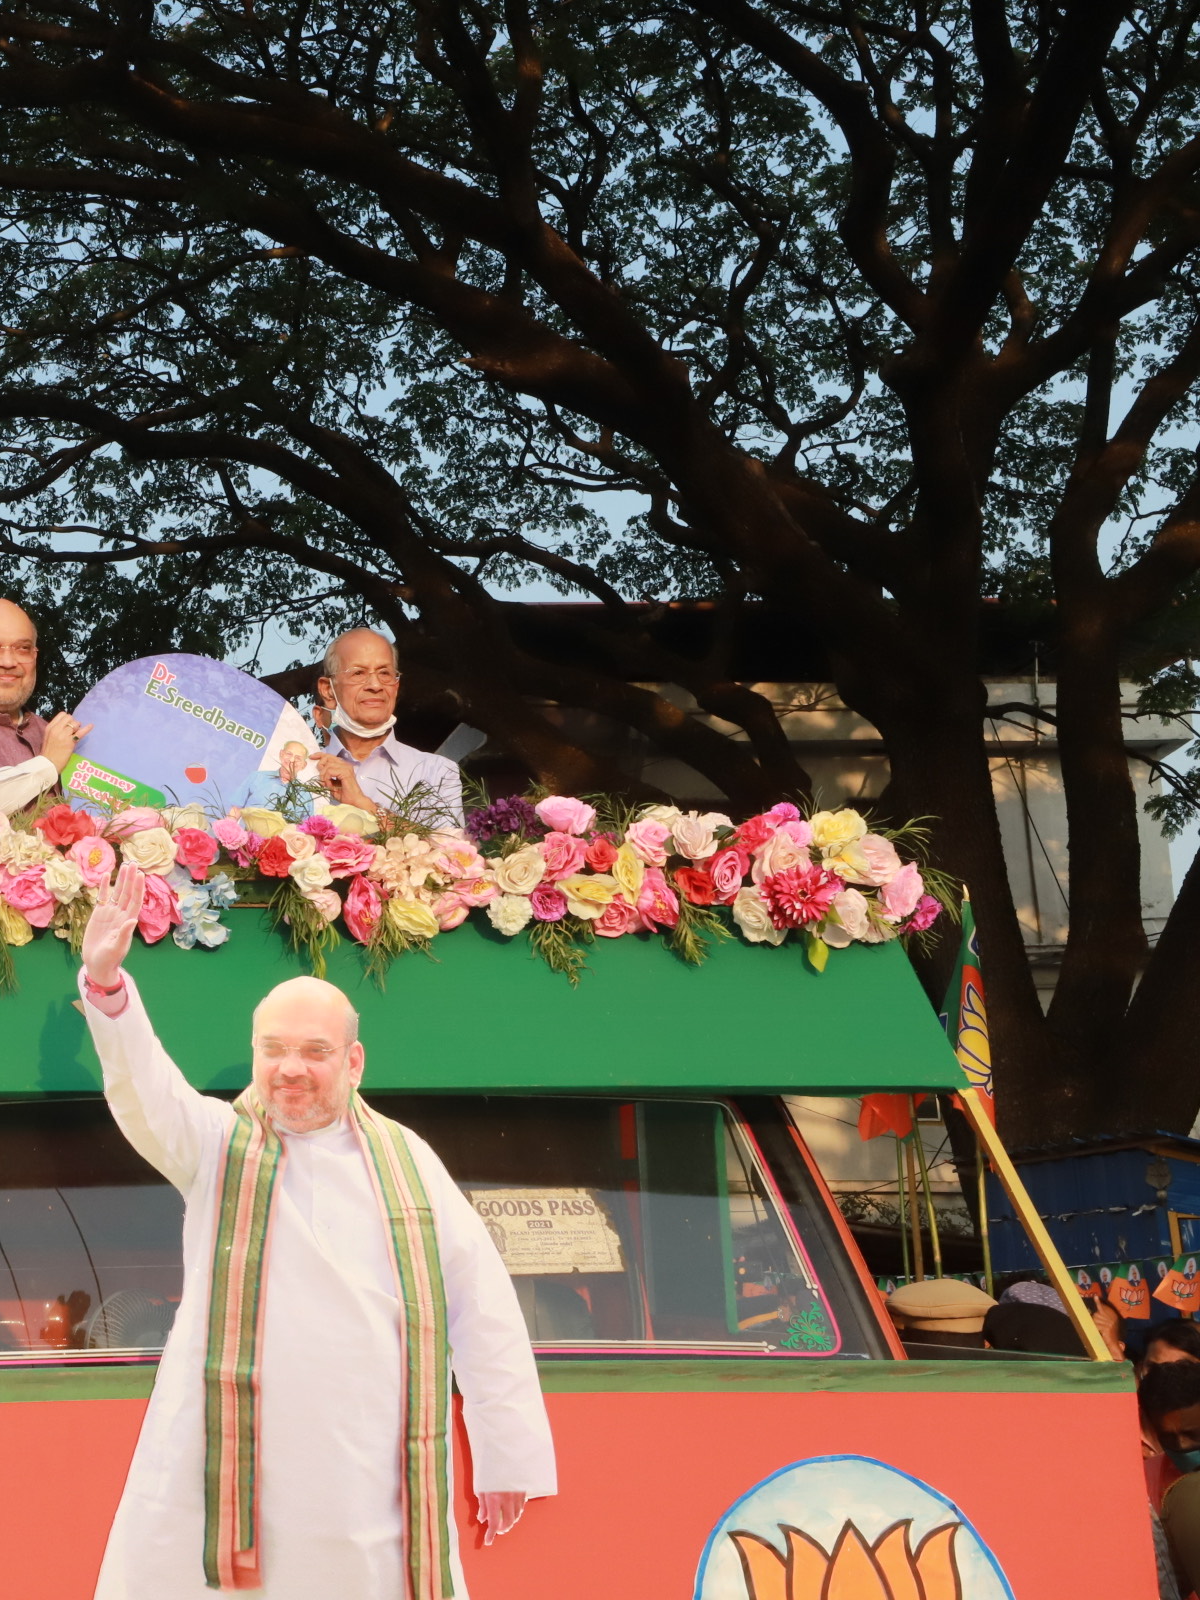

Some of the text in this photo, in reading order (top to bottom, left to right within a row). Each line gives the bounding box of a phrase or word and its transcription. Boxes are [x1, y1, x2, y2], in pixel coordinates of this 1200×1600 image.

[151, 661, 176, 685] Dr
[144, 678, 267, 750] E.Sreedharan
[73, 771, 91, 784] of
[76, 760, 137, 793] Journey
[476, 1199, 596, 1217] GOODS PASS
